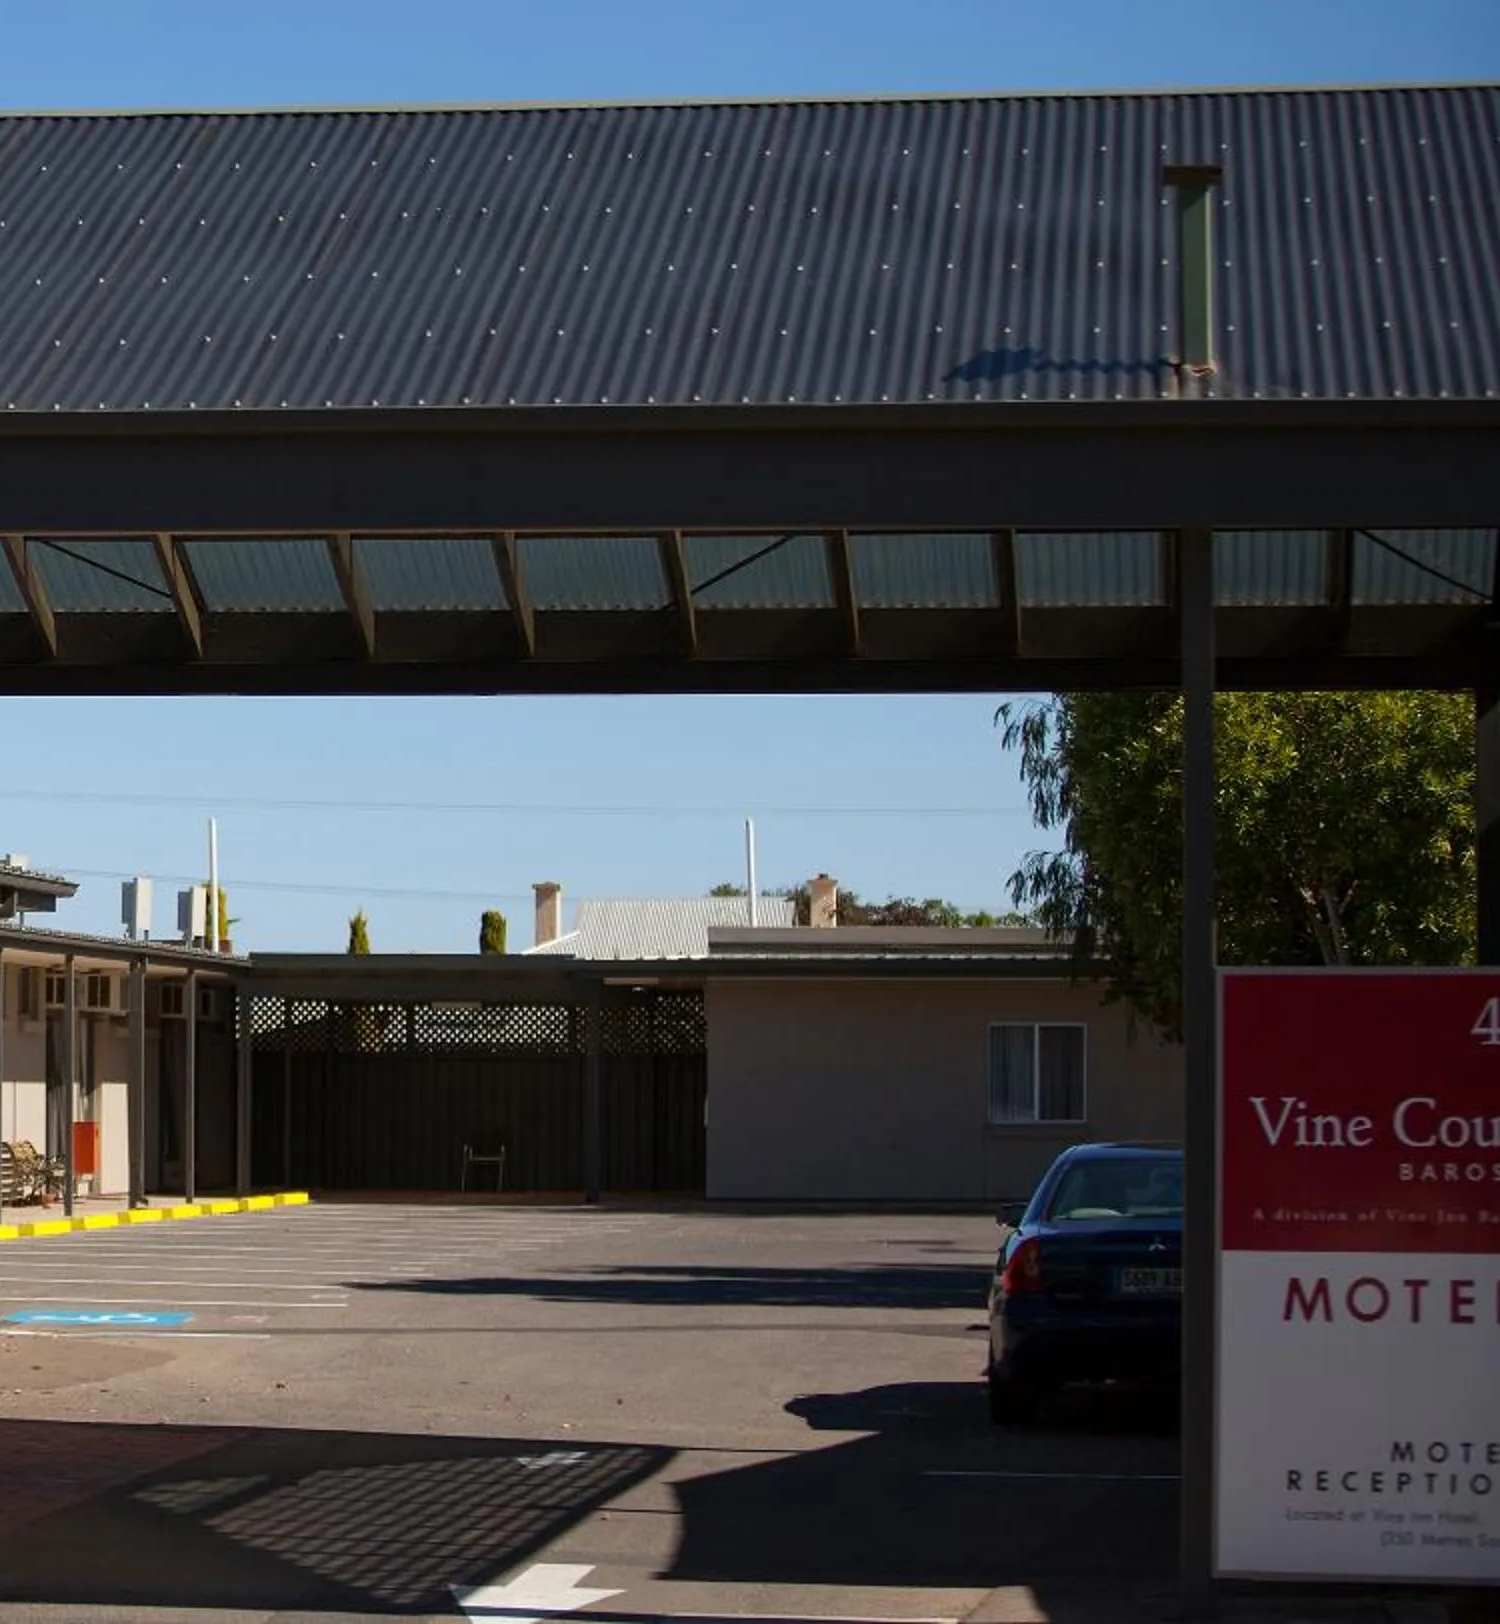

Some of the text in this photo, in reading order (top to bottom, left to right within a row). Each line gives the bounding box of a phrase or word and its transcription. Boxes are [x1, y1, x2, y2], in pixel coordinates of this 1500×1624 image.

[1249, 1097, 1373, 1147] Vine
[1272, 1208, 1349, 1223] division
[1358, 1209, 1377, 1222] of
[1282, 1277, 1500, 1324] MOTE
[1286, 1470, 1492, 1496] RECEPTIO
